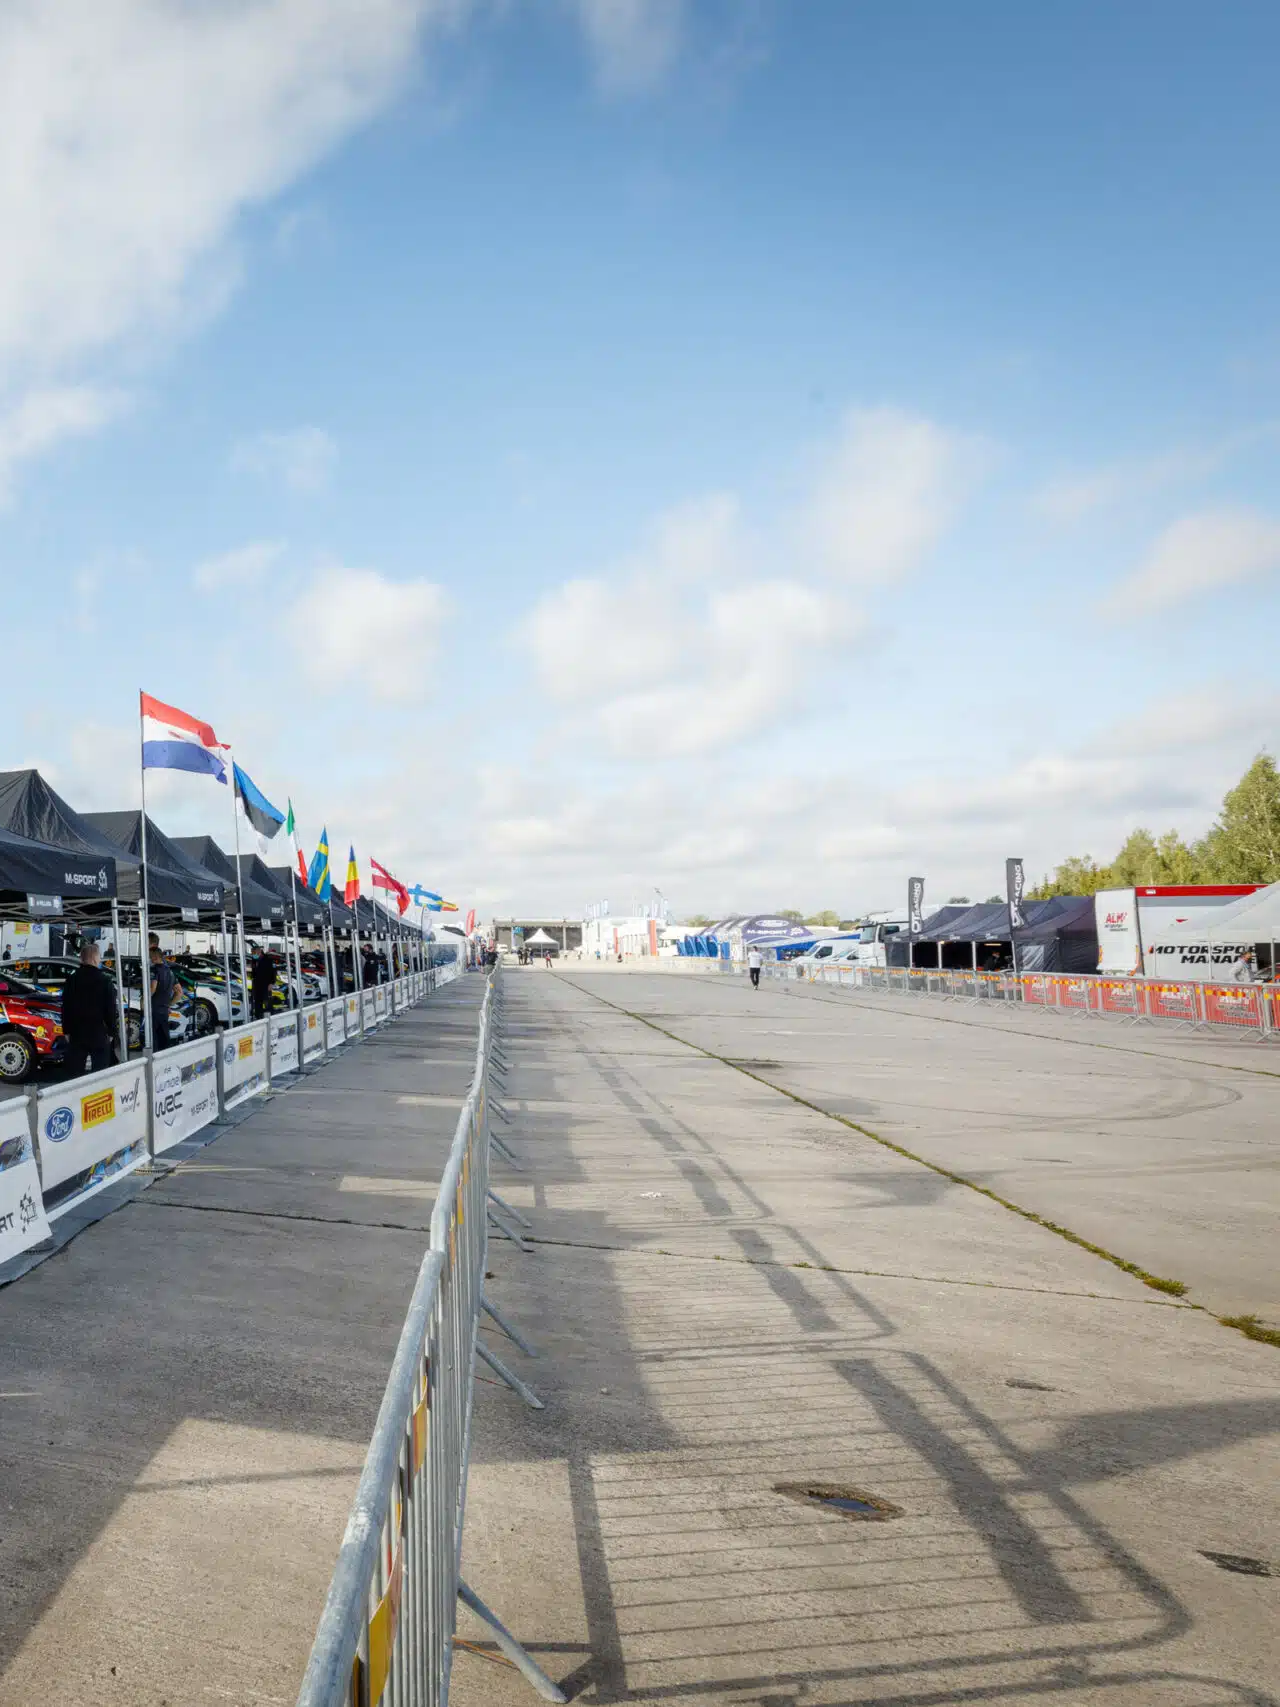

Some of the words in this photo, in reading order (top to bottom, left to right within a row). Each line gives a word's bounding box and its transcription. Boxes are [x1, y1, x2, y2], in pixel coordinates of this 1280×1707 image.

[65, 873, 96, 886] M-SPORT
[84, 1093, 113, 1123] PIRELLI
[155, 1090, 183, 1118] WRC
[51, 1113, 70, 1138] Ford
